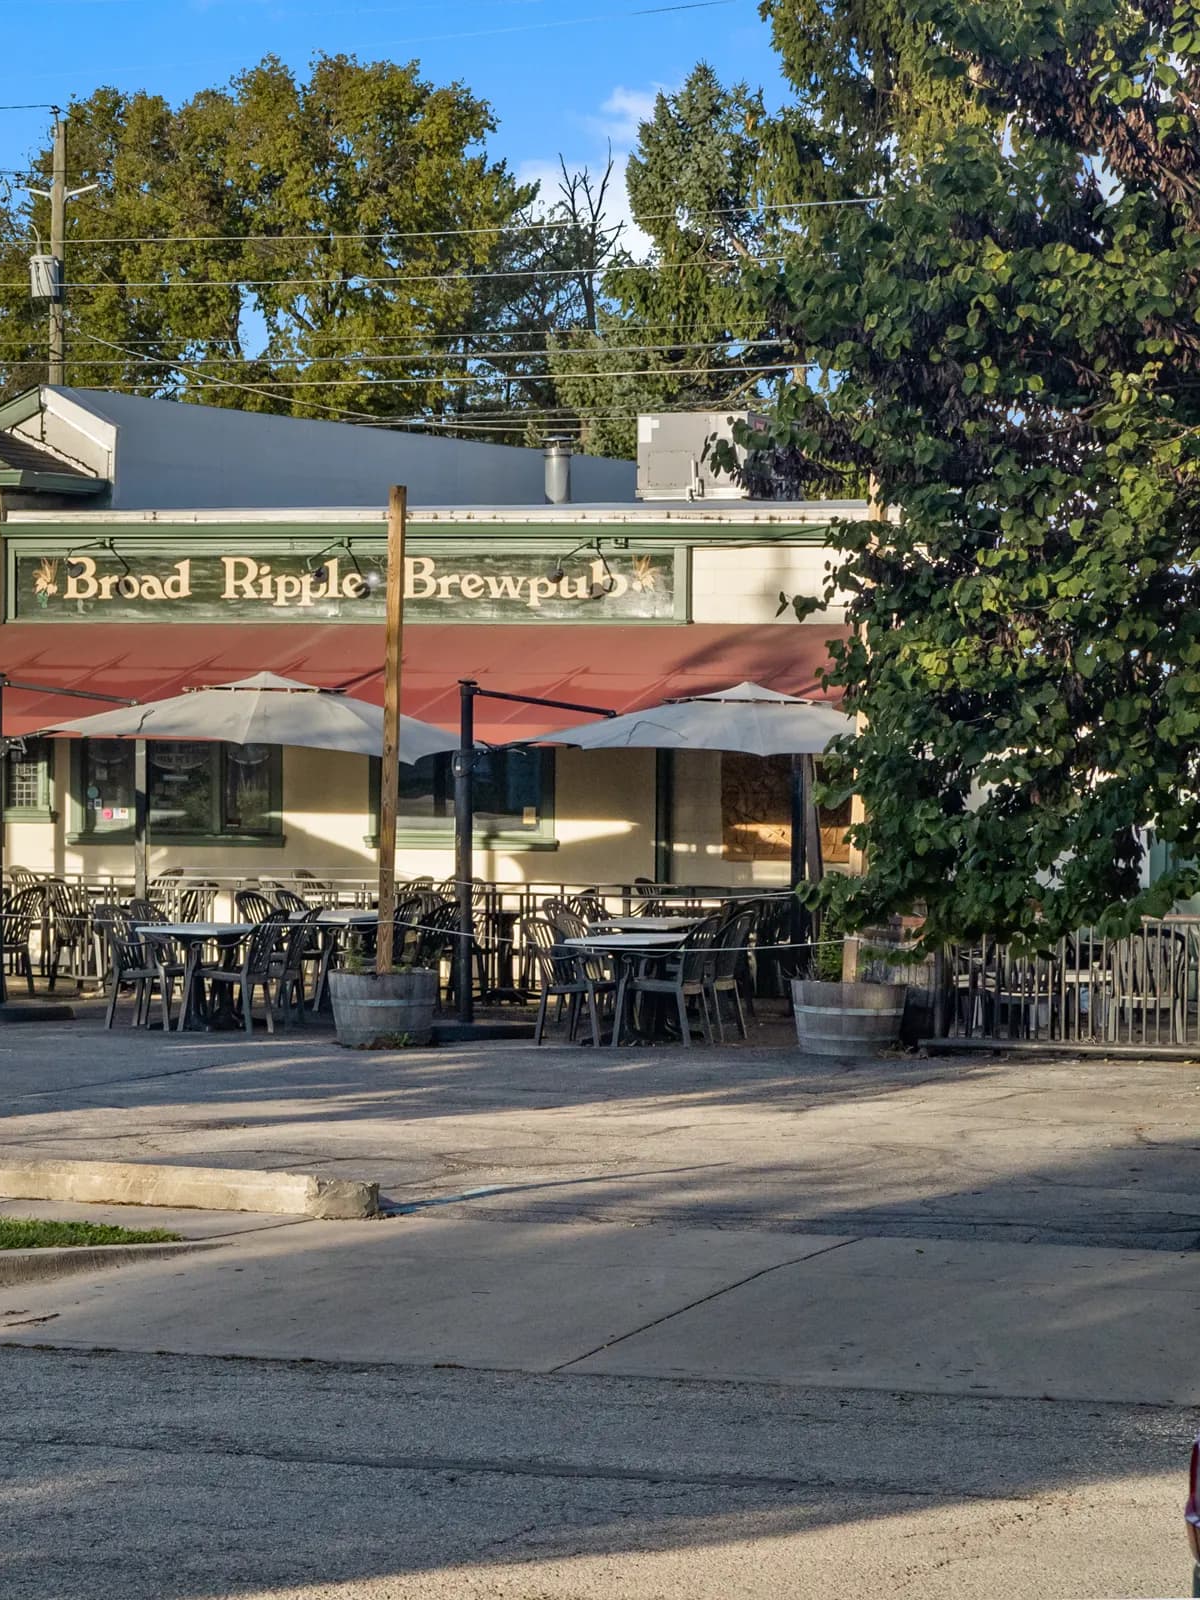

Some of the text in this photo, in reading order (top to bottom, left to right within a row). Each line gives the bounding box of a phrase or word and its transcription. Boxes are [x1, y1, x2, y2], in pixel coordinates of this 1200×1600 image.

[63, 556, 628, 607] Broad Ripple Brewpub
